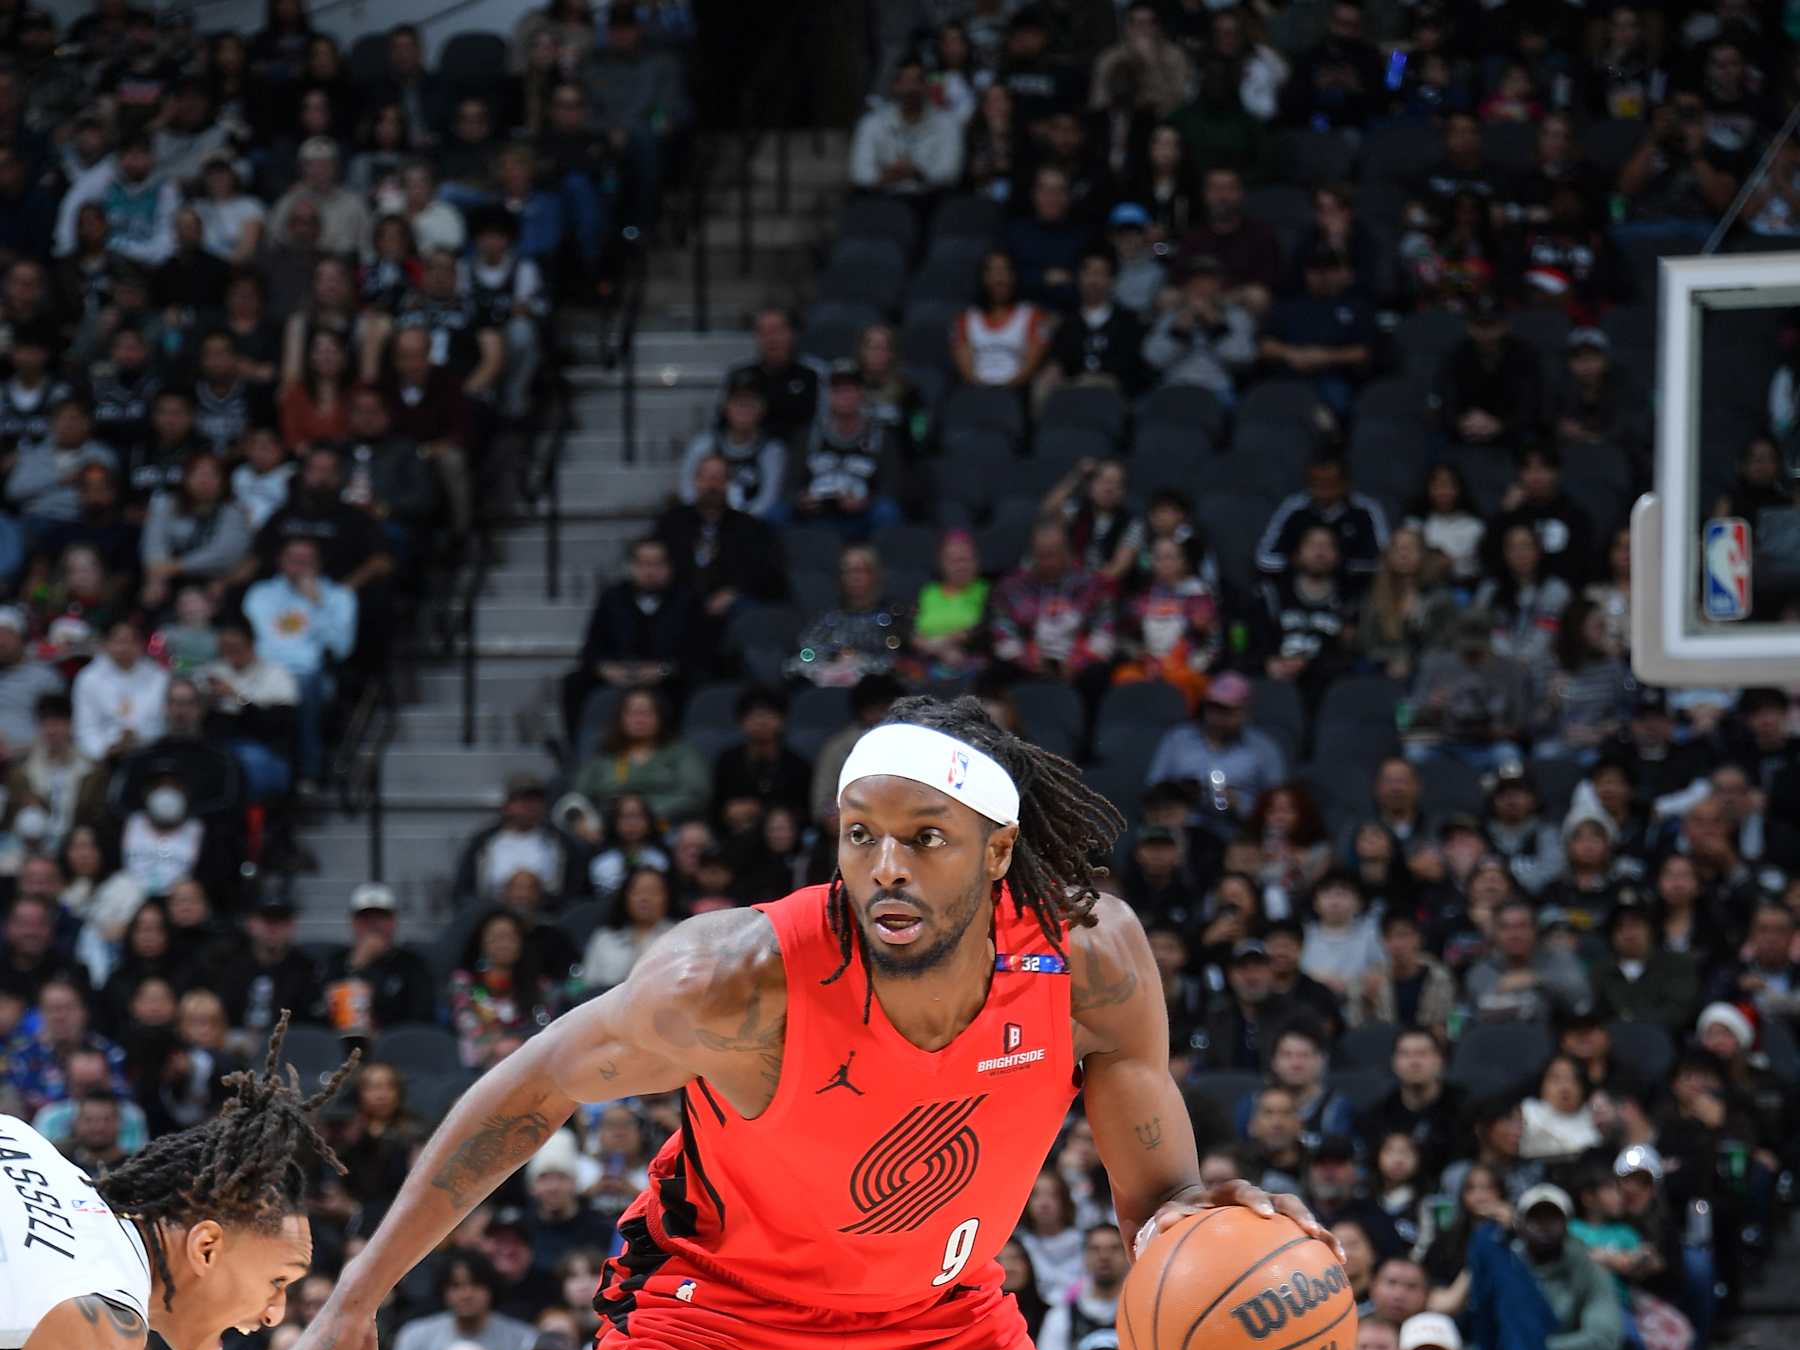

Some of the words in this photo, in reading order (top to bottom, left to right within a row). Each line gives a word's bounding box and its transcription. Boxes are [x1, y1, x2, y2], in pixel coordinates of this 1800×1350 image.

[1021, 957, 1040, 971] 32
[977, 1049, 1045, 1072] BRIGHTSIDE
[931, 1217, 980, 1287] 9
